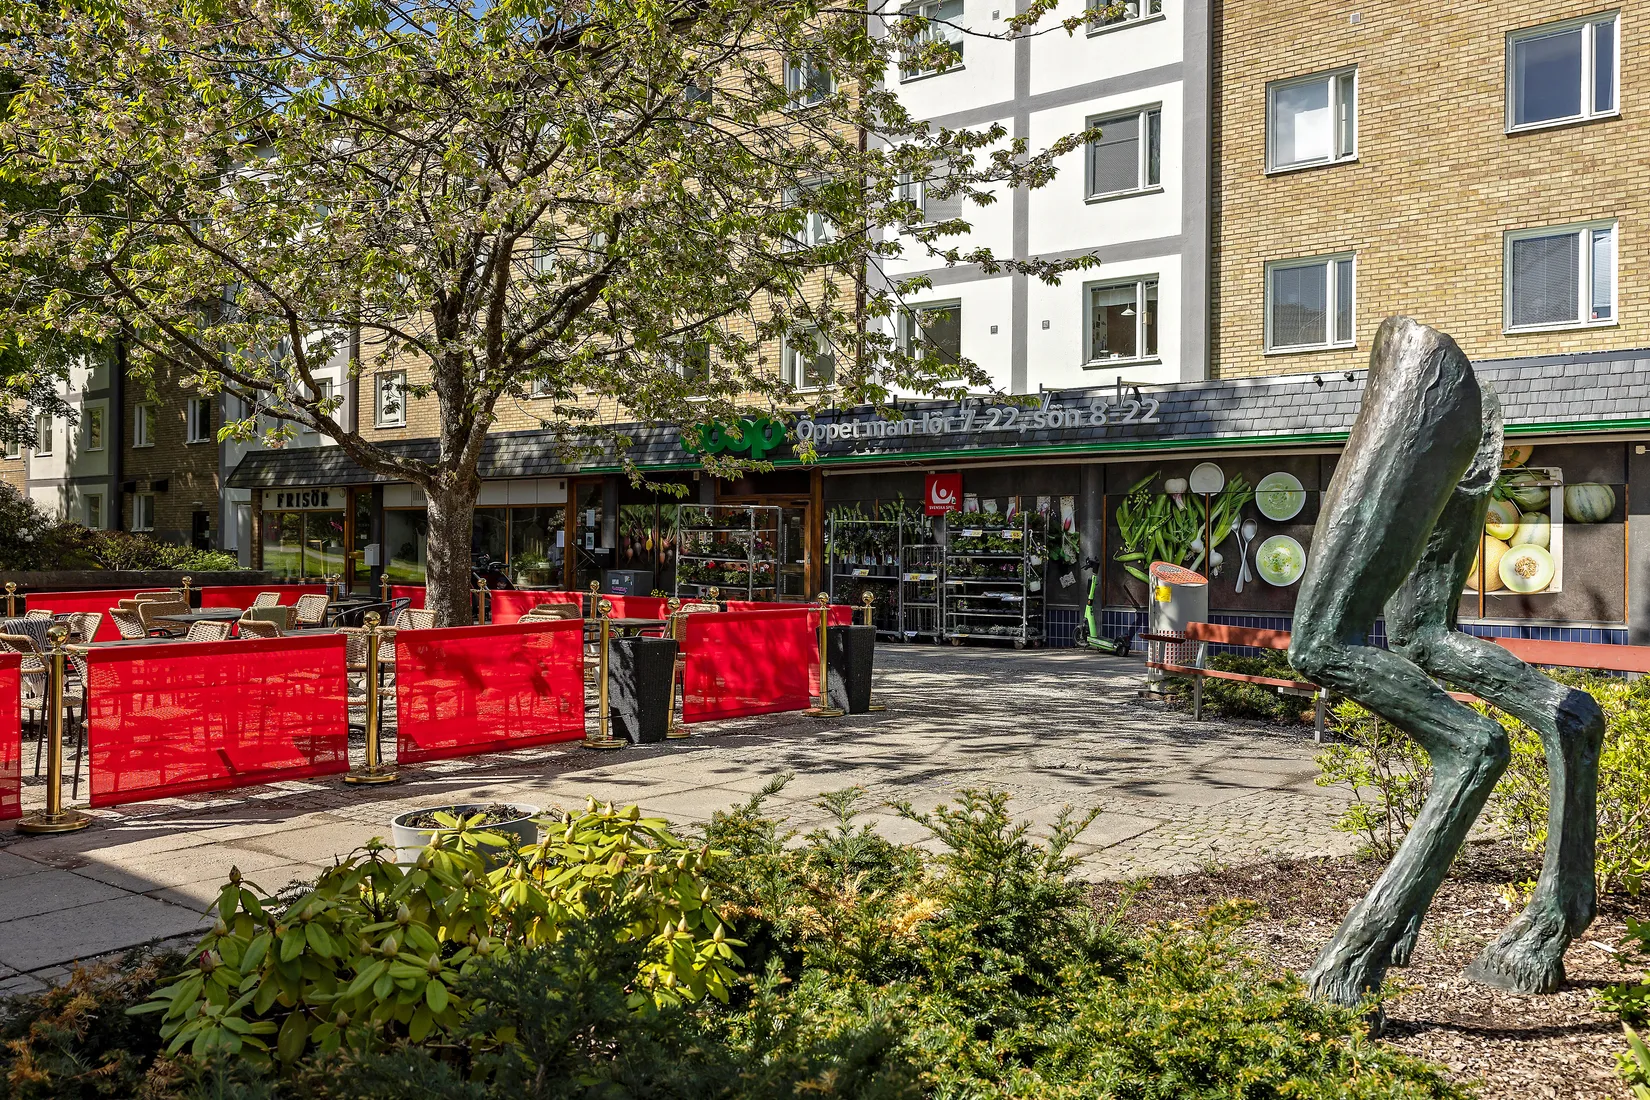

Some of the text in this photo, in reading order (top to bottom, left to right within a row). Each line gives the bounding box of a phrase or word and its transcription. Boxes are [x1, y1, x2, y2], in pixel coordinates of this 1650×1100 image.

[796, 414, 861, 446] Öppet
[1033, 403, 1081, 428] sön
[276, 489, 329, 508] FRISÖR
